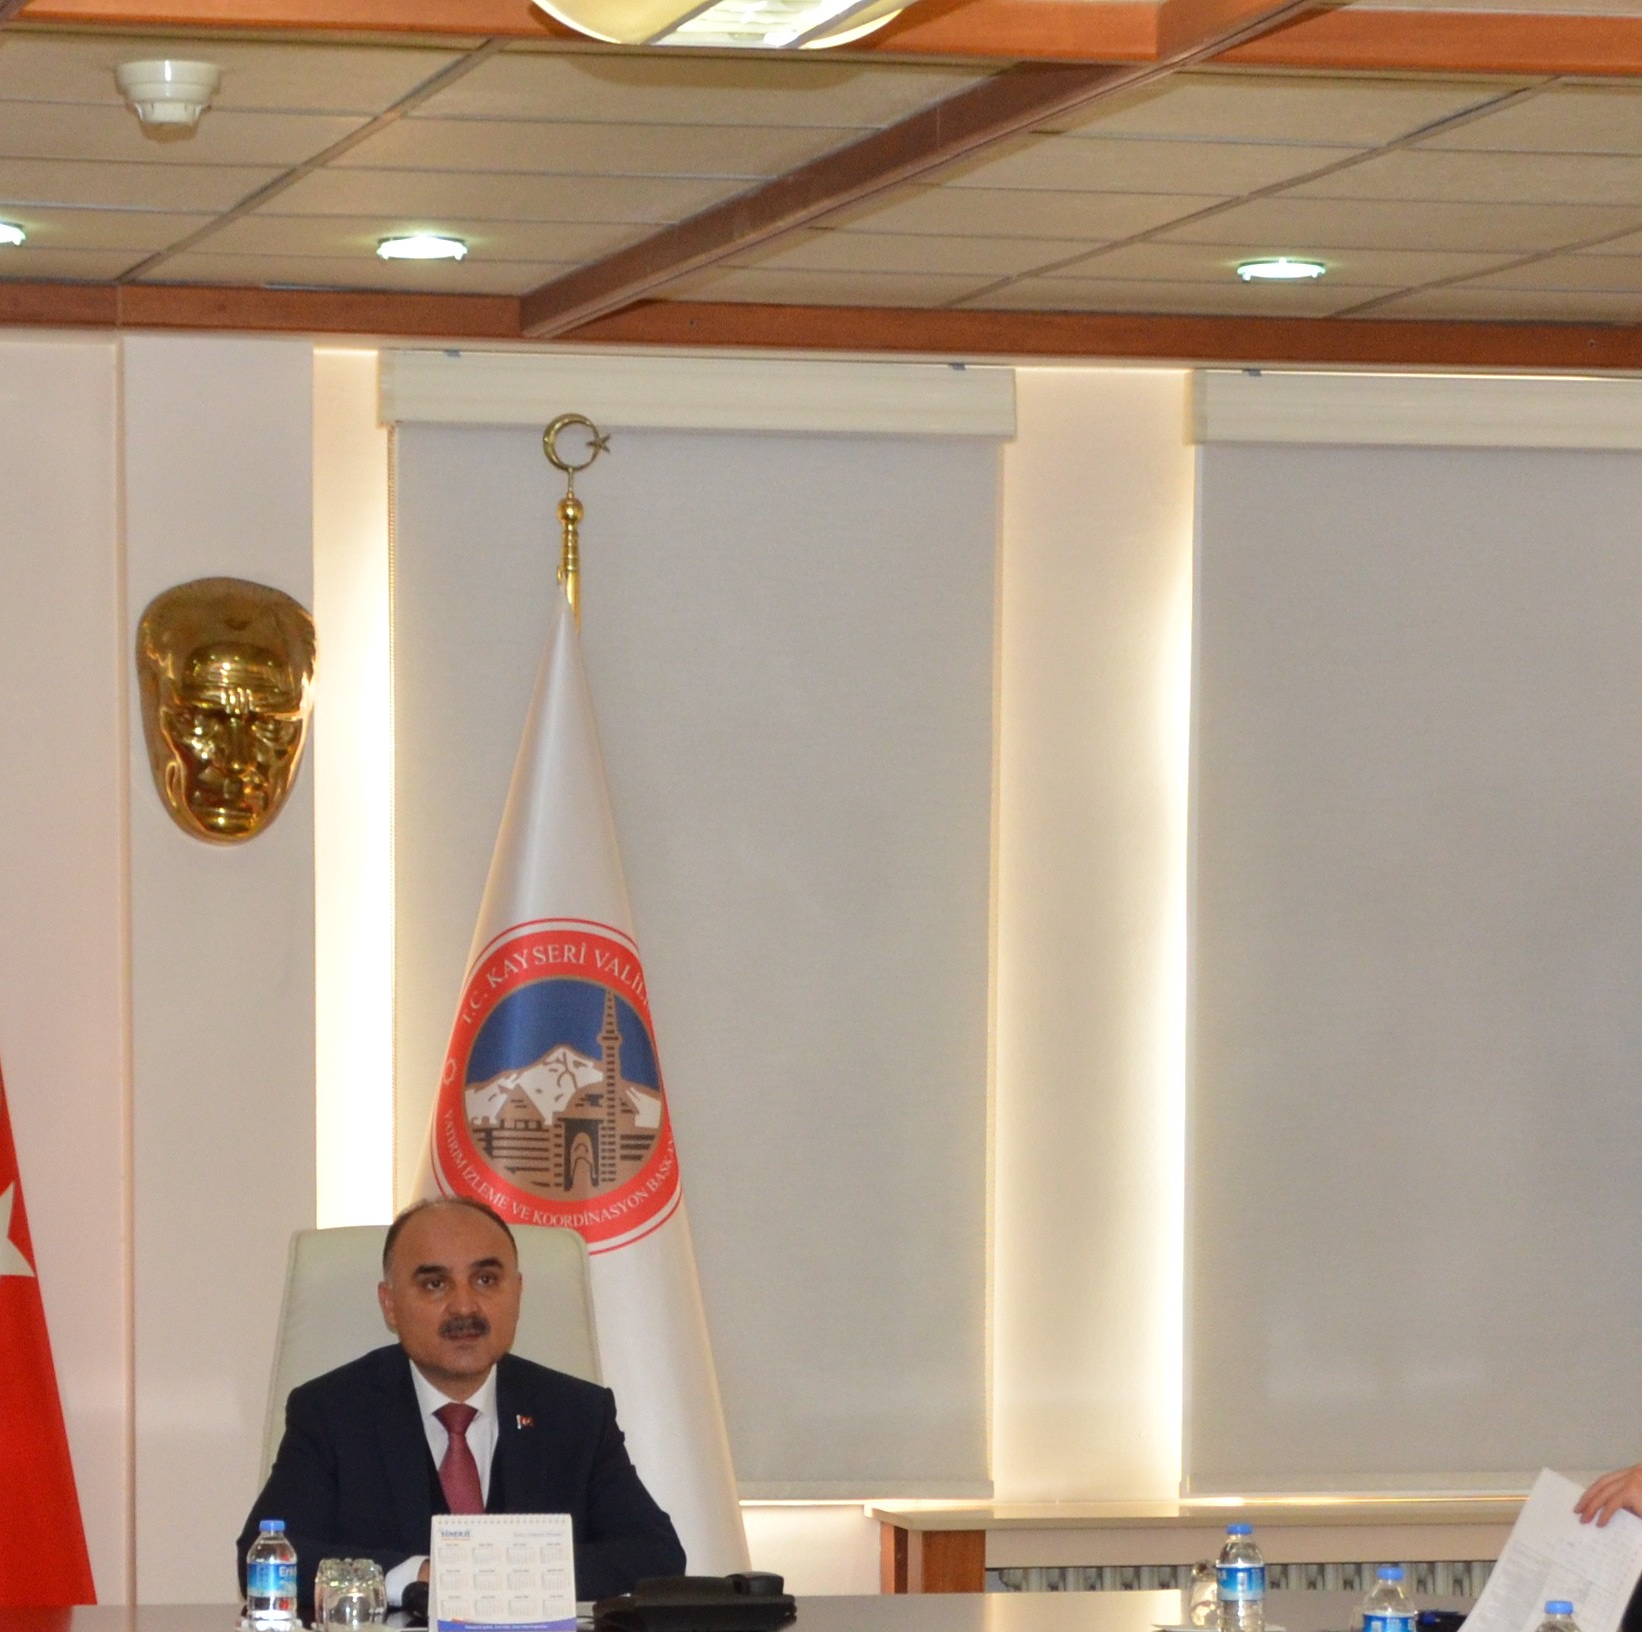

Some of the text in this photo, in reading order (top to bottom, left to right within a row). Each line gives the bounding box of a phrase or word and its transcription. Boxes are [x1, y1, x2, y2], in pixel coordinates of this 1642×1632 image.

[462, 991, 489, 1025] T.C.
[486, 942, 587, 989] KAYSERİ
[511, 1203, 531, 1220] VE
[532, 1189, 650, 1227] KOORDİNASYON
